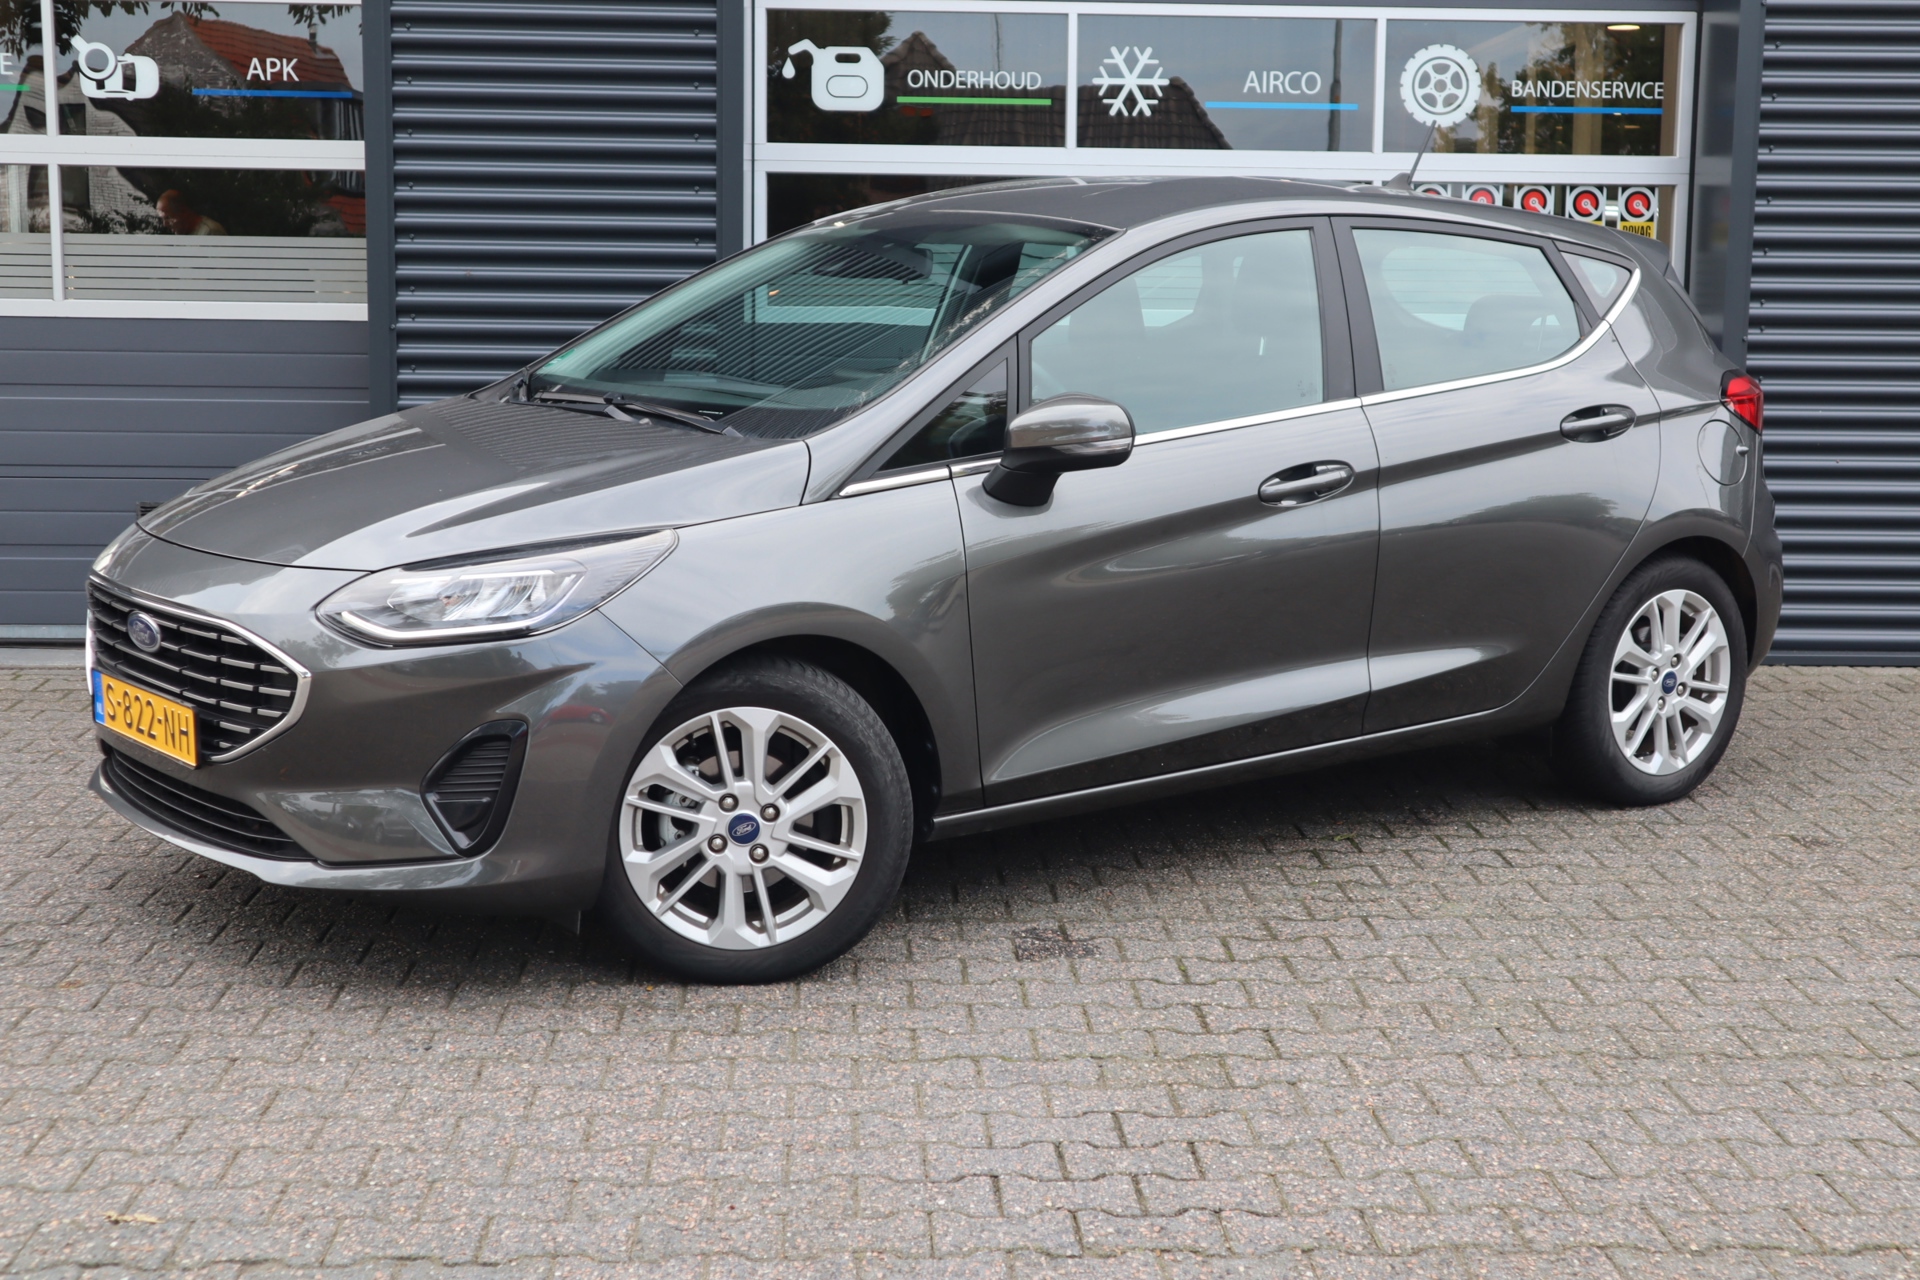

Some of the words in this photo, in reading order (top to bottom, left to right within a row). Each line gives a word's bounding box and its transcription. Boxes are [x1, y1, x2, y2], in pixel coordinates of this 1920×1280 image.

[246, 57, 300, 82] APK
[907, 69, 1042, 90] ONDERHOUD
[1243, 71, 1322, 95] AIRCO
[1511, 79, 1665, 100] BANDENSERVICE
[105, 682, 190, 756] S-822-NH
